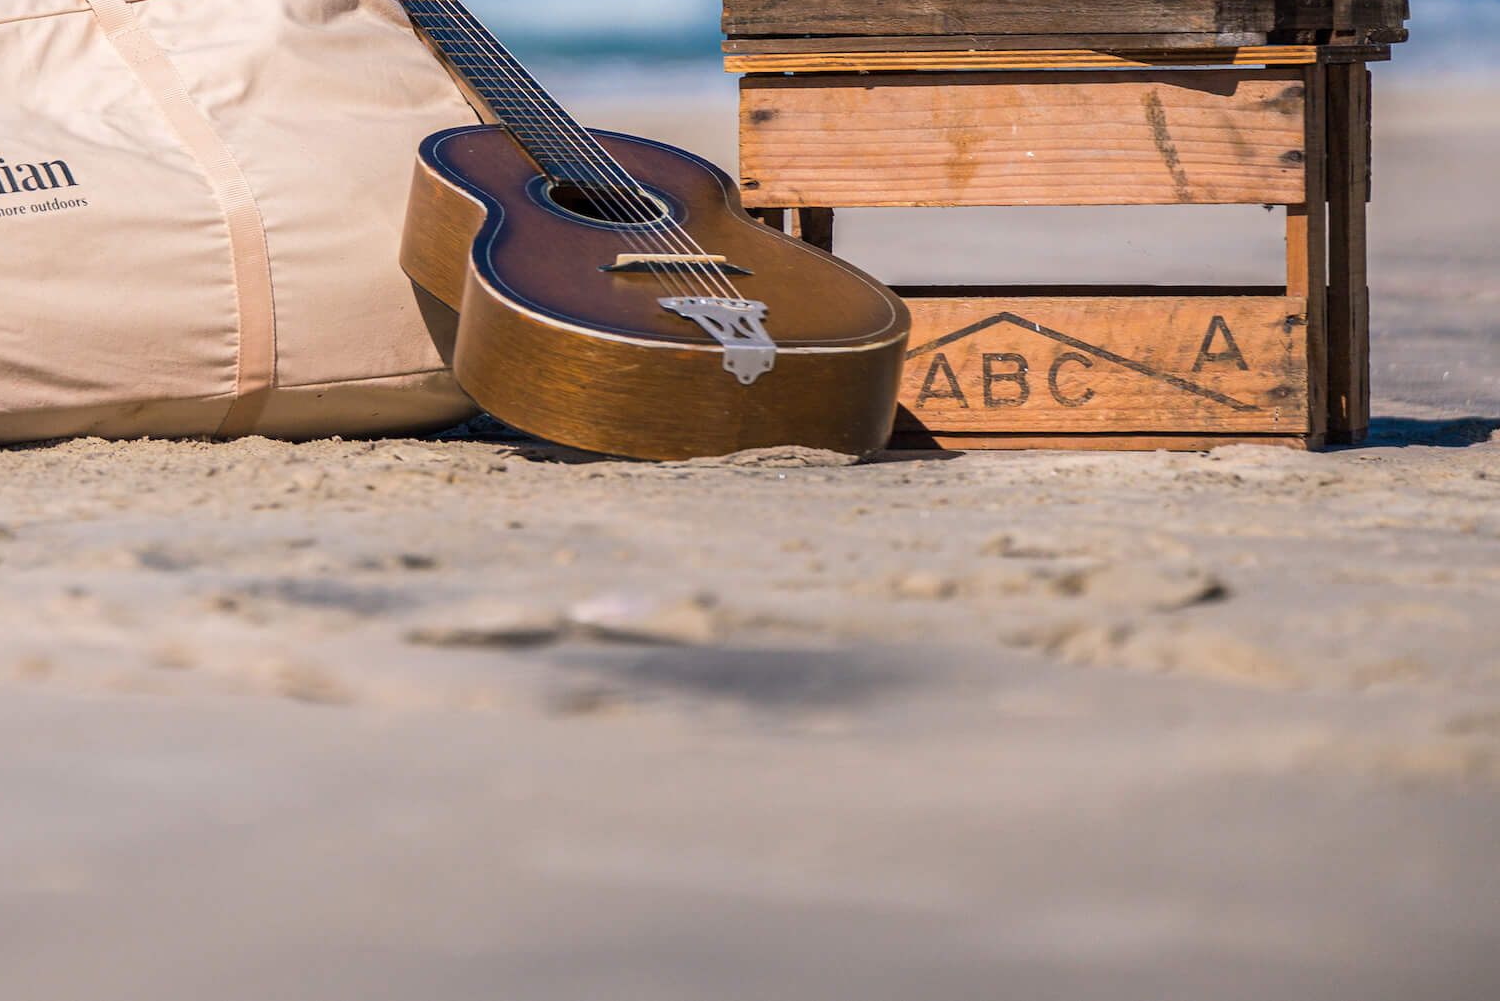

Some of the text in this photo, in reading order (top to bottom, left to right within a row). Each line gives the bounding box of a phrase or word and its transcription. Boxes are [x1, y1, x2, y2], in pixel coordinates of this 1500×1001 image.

[30, 198, 89, 213] outdoors
[1191, 315, 1250, 372] A
[915, 352, 1096, 408] ABC
